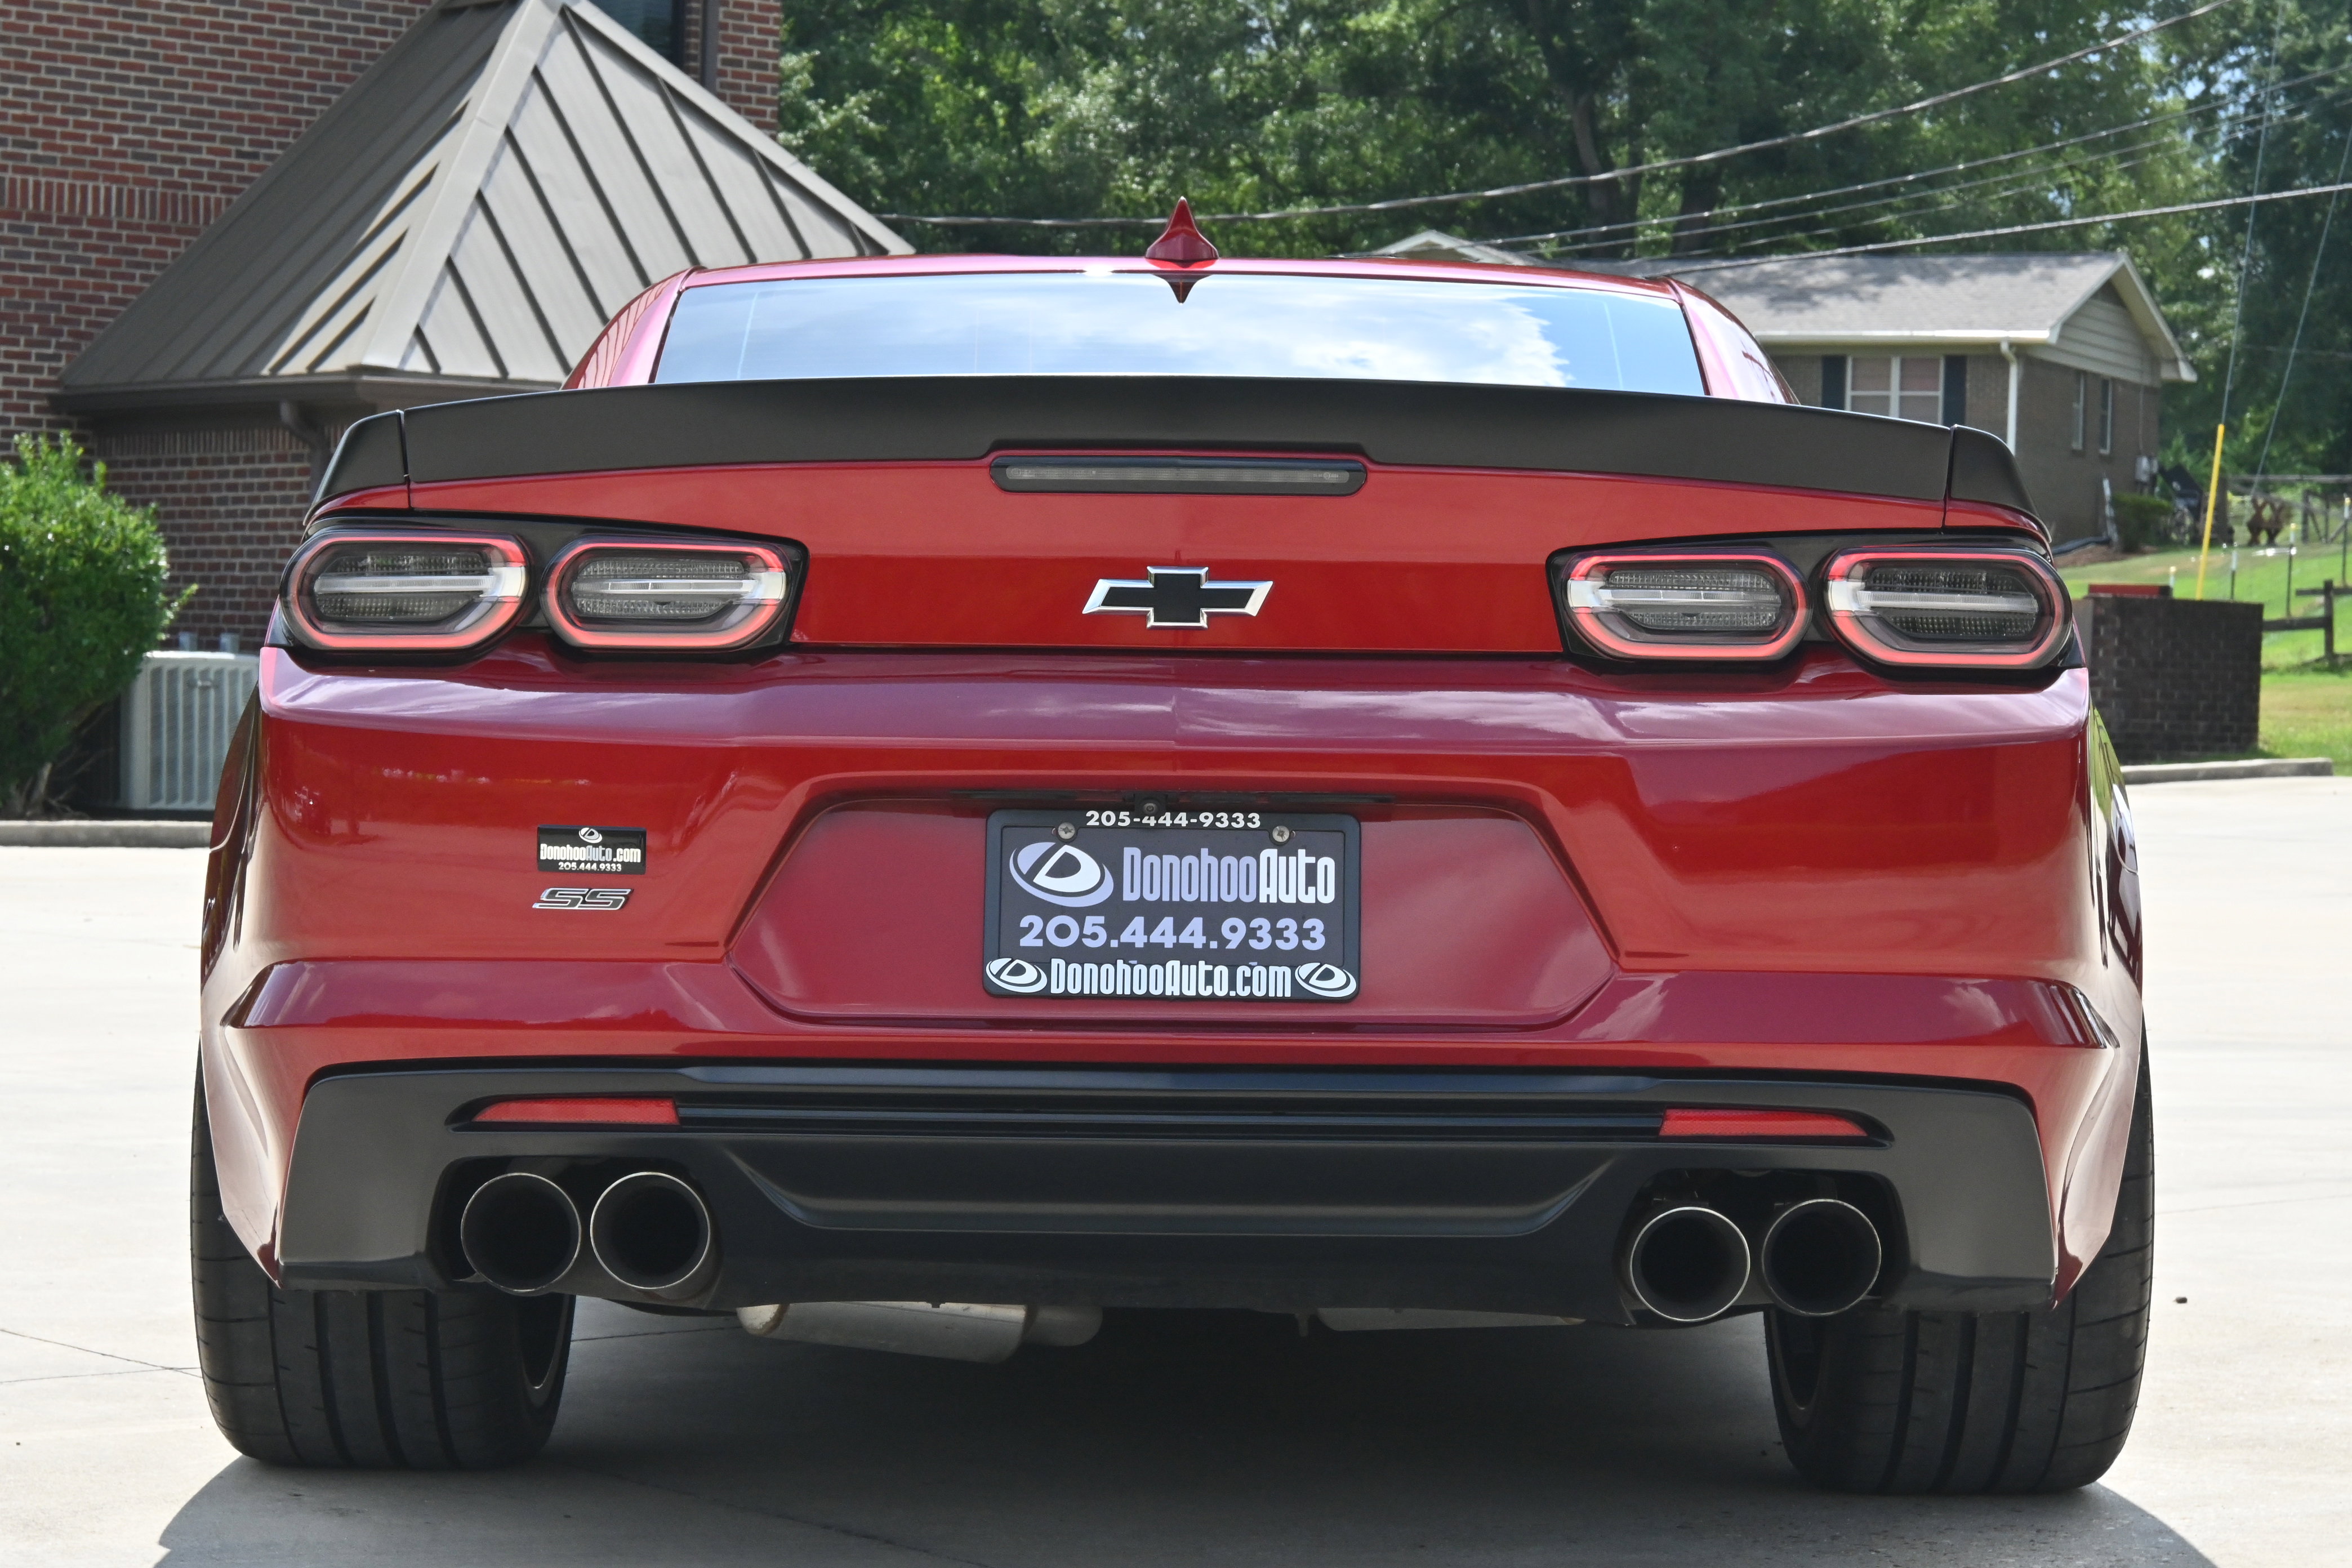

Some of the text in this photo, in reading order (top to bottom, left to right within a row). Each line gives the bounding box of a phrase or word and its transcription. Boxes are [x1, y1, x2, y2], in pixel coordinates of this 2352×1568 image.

[1085, 810, 1261, 829] 205-444-9333
[540, 843, 642, 863] DonohooAuto.com
[558, 862, 622, 872] 205.444.9333
[1122, 847, 1335, 904] DonohooAuto
[532, 888, 633, 910] SS
[1019, 914, 1326, 951] 205.444.9333
[1050, 958, 1291, 997] DonohooAuto.com
